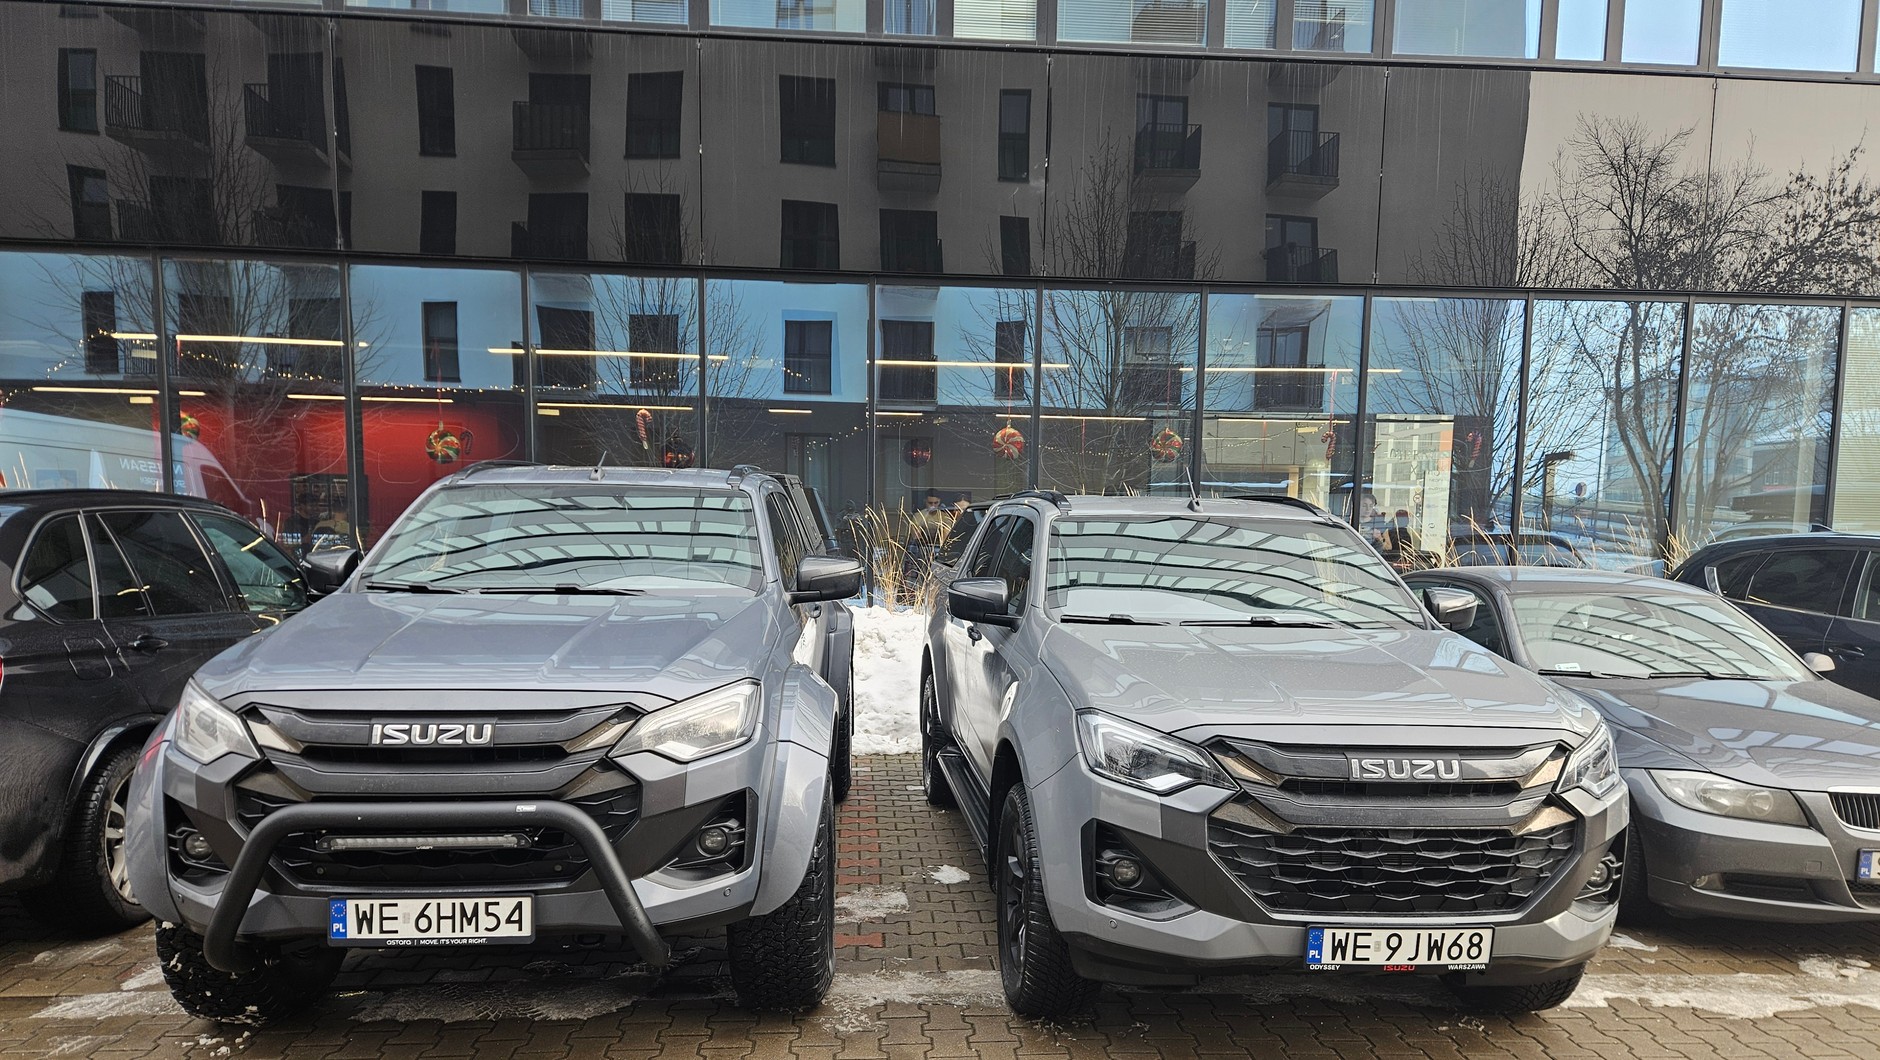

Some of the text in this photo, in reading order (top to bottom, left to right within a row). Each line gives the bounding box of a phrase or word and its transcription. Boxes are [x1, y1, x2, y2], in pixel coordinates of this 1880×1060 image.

[371, 724, 492, 745] ISUZU
[1351, 759, 1460, 779] ISUZU
[1860, 867, 1870, 875] PL
[354, 900, 524, 935] WE 6HM54
[333, 924, 346, 933] PL
[1309, 950, 1321, 959] PL
[1330, 931, 1484, 962] WE 9JW68
